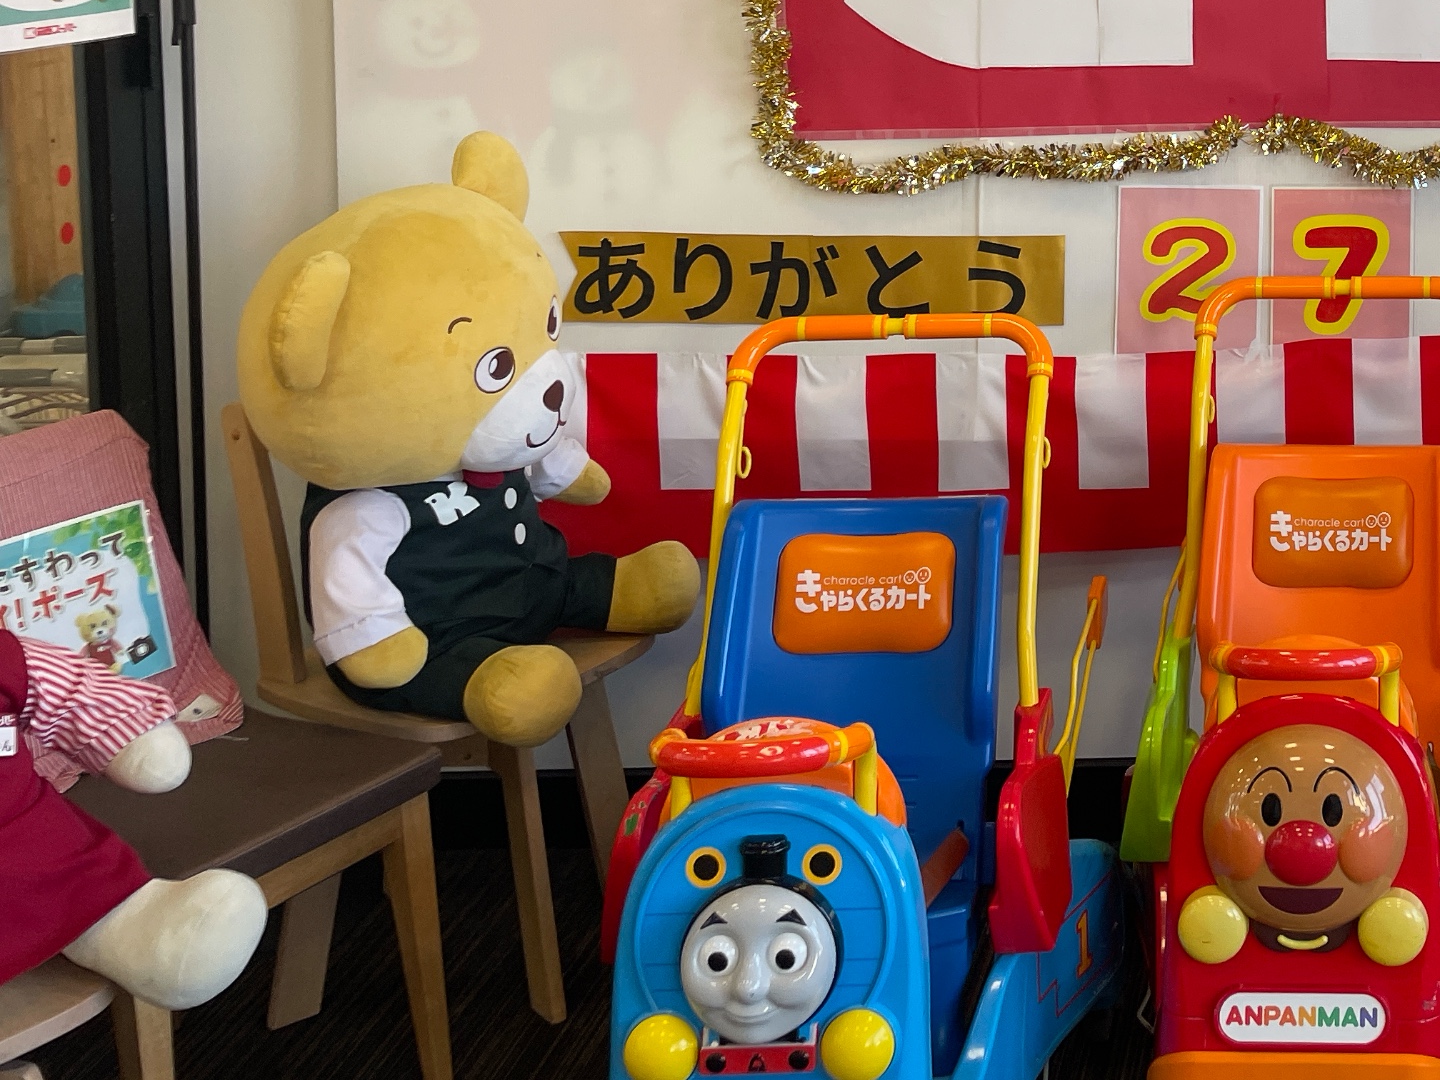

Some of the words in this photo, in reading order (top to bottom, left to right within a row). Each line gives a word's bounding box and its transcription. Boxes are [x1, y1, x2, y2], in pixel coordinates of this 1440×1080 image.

[574, 237, 1027, 319] ありがとう
[1269, 510, 1392, 552] きゃらくるカート
[795, 569, 932, 614] きゃらくるカート
[1075, 909, 1094, 978] 1
[1225, 1005, 1379, 1029] ANPANMAN
